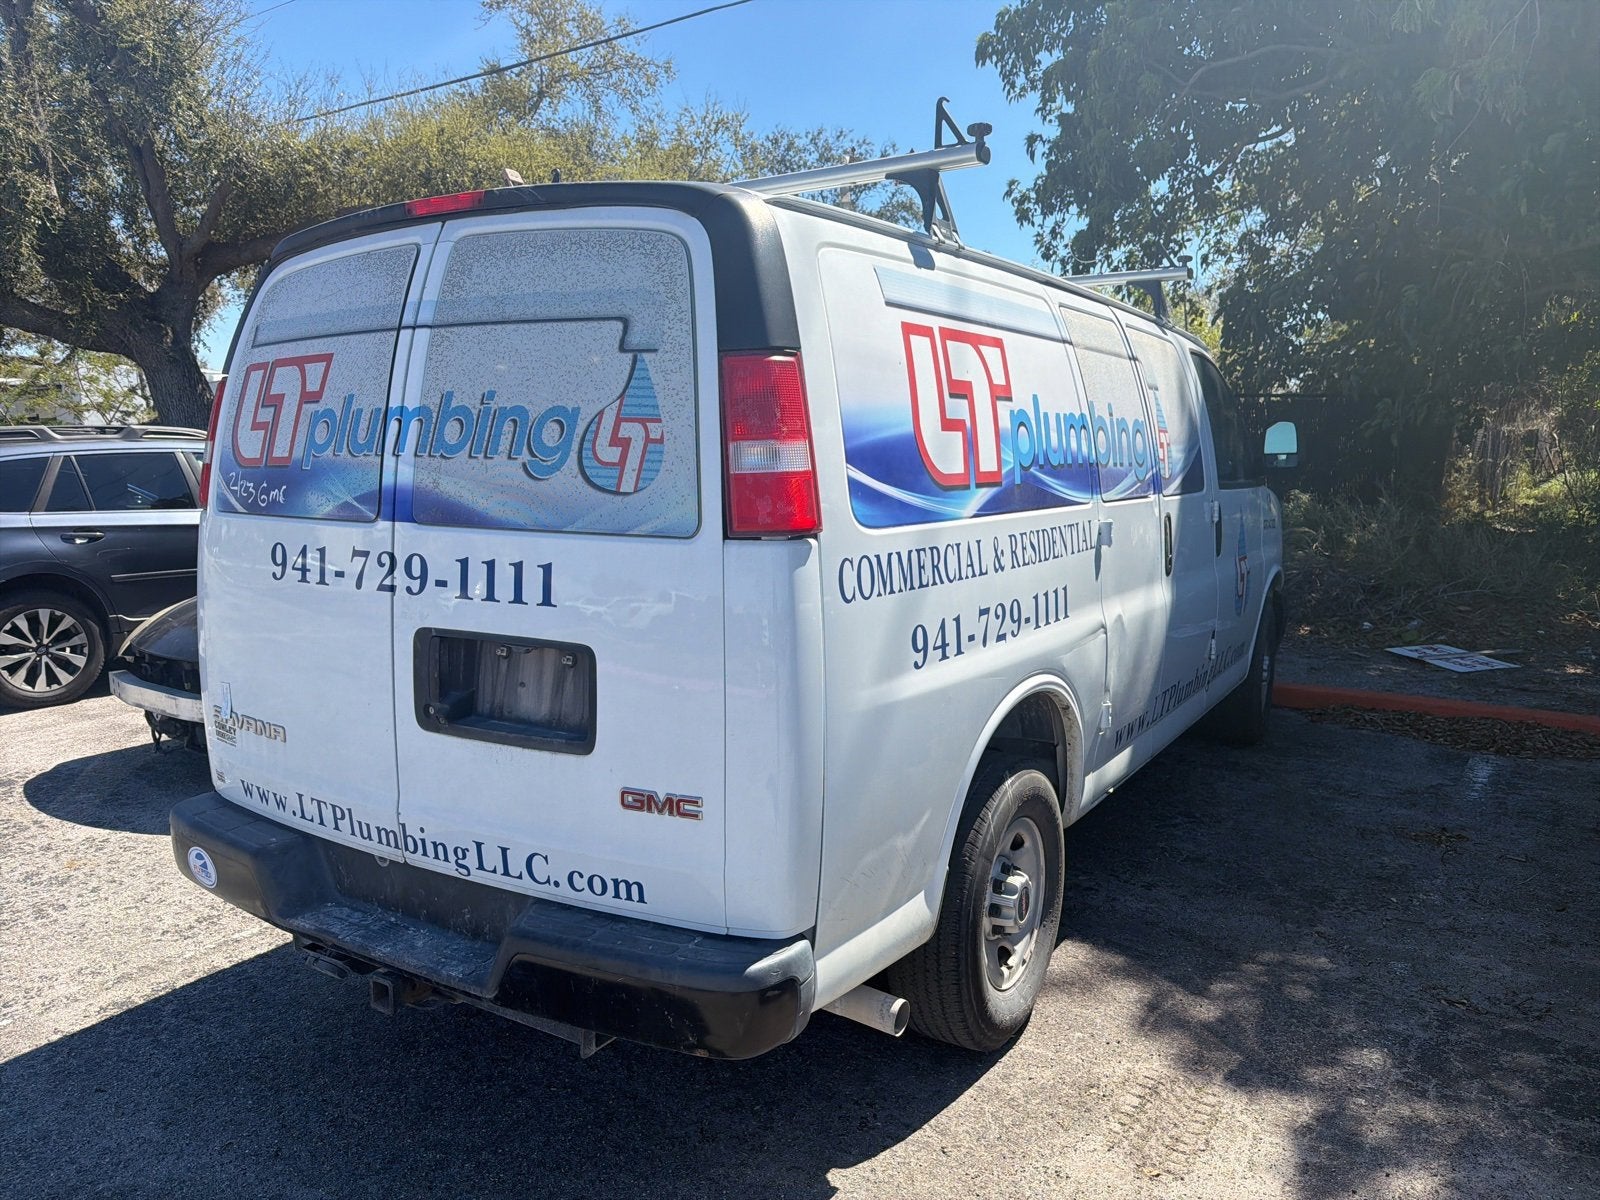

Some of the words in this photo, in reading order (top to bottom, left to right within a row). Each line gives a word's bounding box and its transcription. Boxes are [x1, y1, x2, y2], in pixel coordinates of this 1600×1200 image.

[232, 353, 334, 468] LT
[301, 390, 581, 480] plumbing
[901, 321, 1013, 490] LT
[1010, 393, 1148, 484] plumbing
[270, 541, 559, 609] 941-729-1111
[838, 539, 988, 604] COMMERCIAL
[992, 536, 1006, 574] &
[1010, 519, 1095, 570] RESIDENTIAL
[911, 584, 1071, 670] 941-729-1111
[240, 778, 648, 905] www.LTPlumbingLLC.com
[620, 786, 703, 821] GMC
